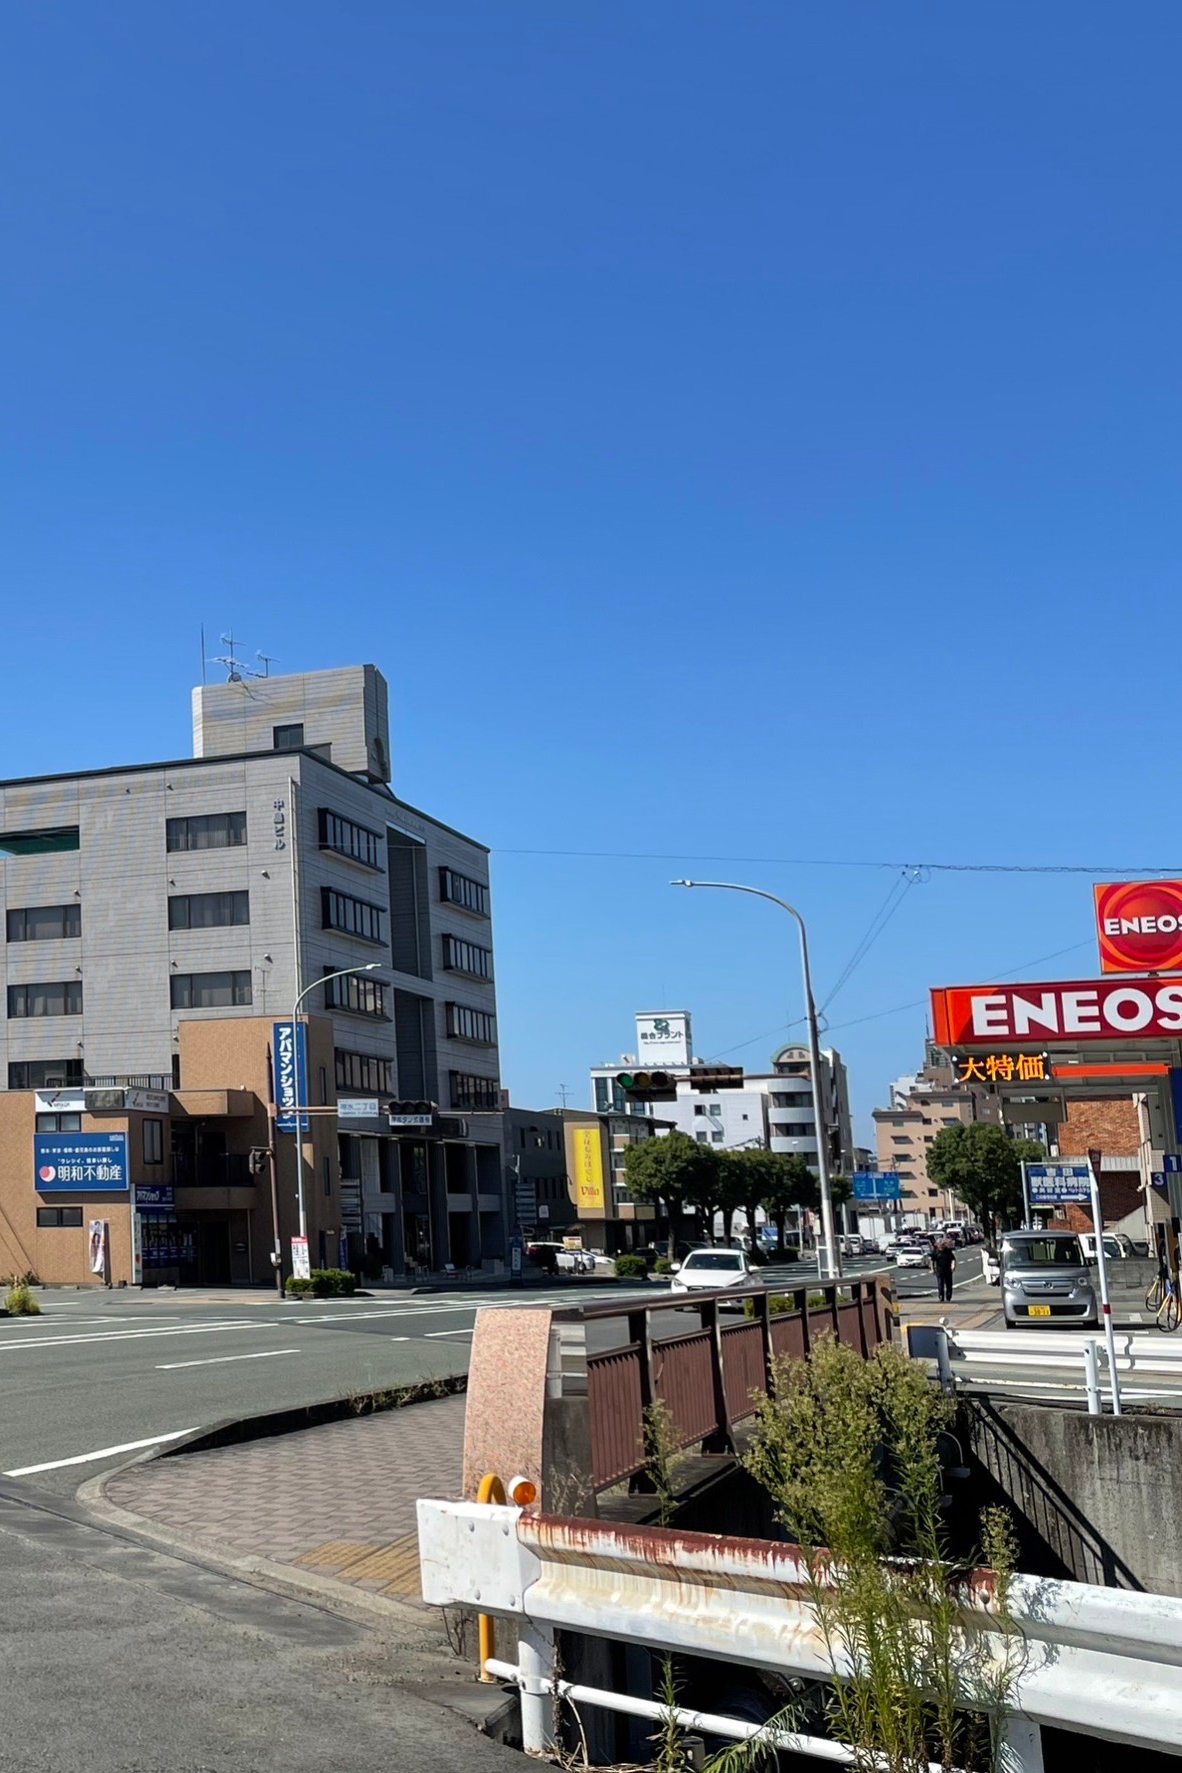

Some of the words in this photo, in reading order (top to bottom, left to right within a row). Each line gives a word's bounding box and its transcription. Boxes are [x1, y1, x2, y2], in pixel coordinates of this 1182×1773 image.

[971, 986, 1182, 1036] ENEOS
[958, 1053, 1045, 1083] 大特価
[57, 1164, 123, 1182] 明和不動産
[1169, 1156, 1178, 1172] 1
[1154, 1173, 1164, 1186] 3
